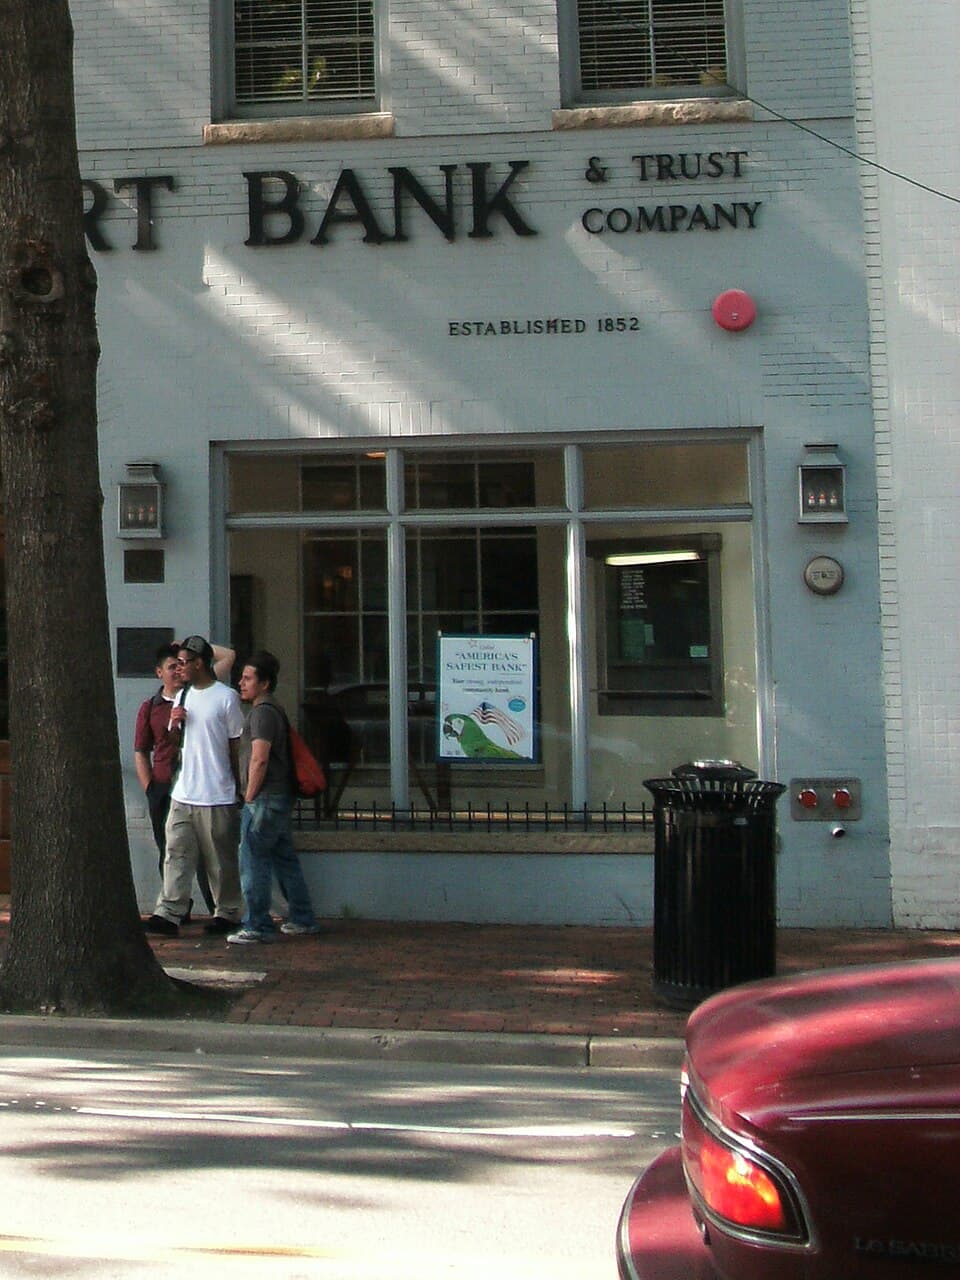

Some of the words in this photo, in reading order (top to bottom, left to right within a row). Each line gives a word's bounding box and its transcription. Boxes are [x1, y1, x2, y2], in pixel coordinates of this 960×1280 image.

[585, 156, 609, 183] &
[631, 151, 748, 182] TRUST
[241, 160, 539, 247] BANK
[581, 201, 762, 234] COMPANY
[448, 318, 587, 337] ESTABLISHED
[597, 317, 640, 332] 1852
[446, 662, 487, 672] SAFEST
